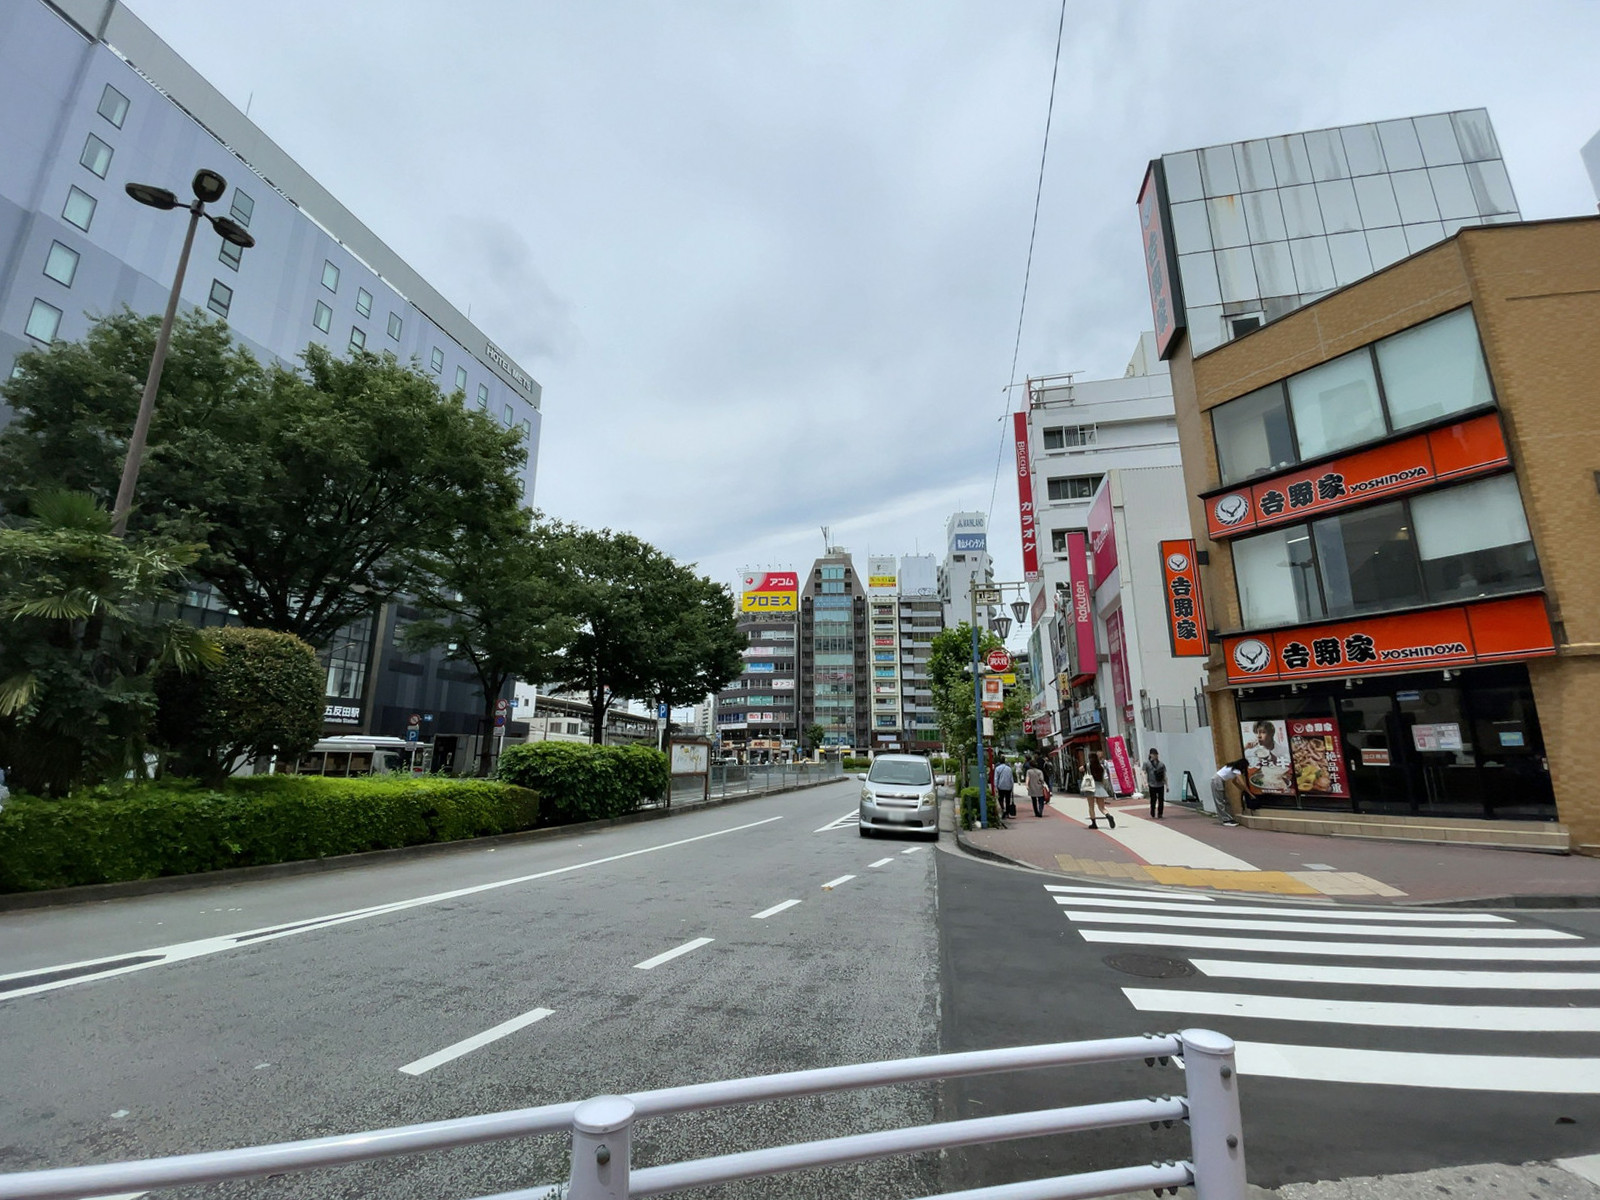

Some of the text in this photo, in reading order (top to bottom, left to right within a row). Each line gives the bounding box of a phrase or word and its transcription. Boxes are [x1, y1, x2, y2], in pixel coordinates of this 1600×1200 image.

[486, 345, 511, 375] HOTEL
[511, 367, 532, 391] METS
[1018, 457, 1028, 477] ECHO
[1349, 465, 1428, 494] YOSHINOYA
[1259, 472, 1346, 517] 吉野家
[1021, 501, 1036, 553] カラオケ
[769, 577, 794, 586] アコム
[746, 595, 792, 607] プロミス
[1075, 580, 1088, 622] Rakuten
[1170, 575, 1198, 641] 吉野家
[1281, 632, 1377, 670] 吉野家
[1380, 642, 1467, 661] YOSHINOYA
[323, 705, 360, 718] 五反田駅
[660, 705, 666, 717] P
[409, 730, 417, 740] P
[1325, 751, 1343, 793] 絶品牛重
